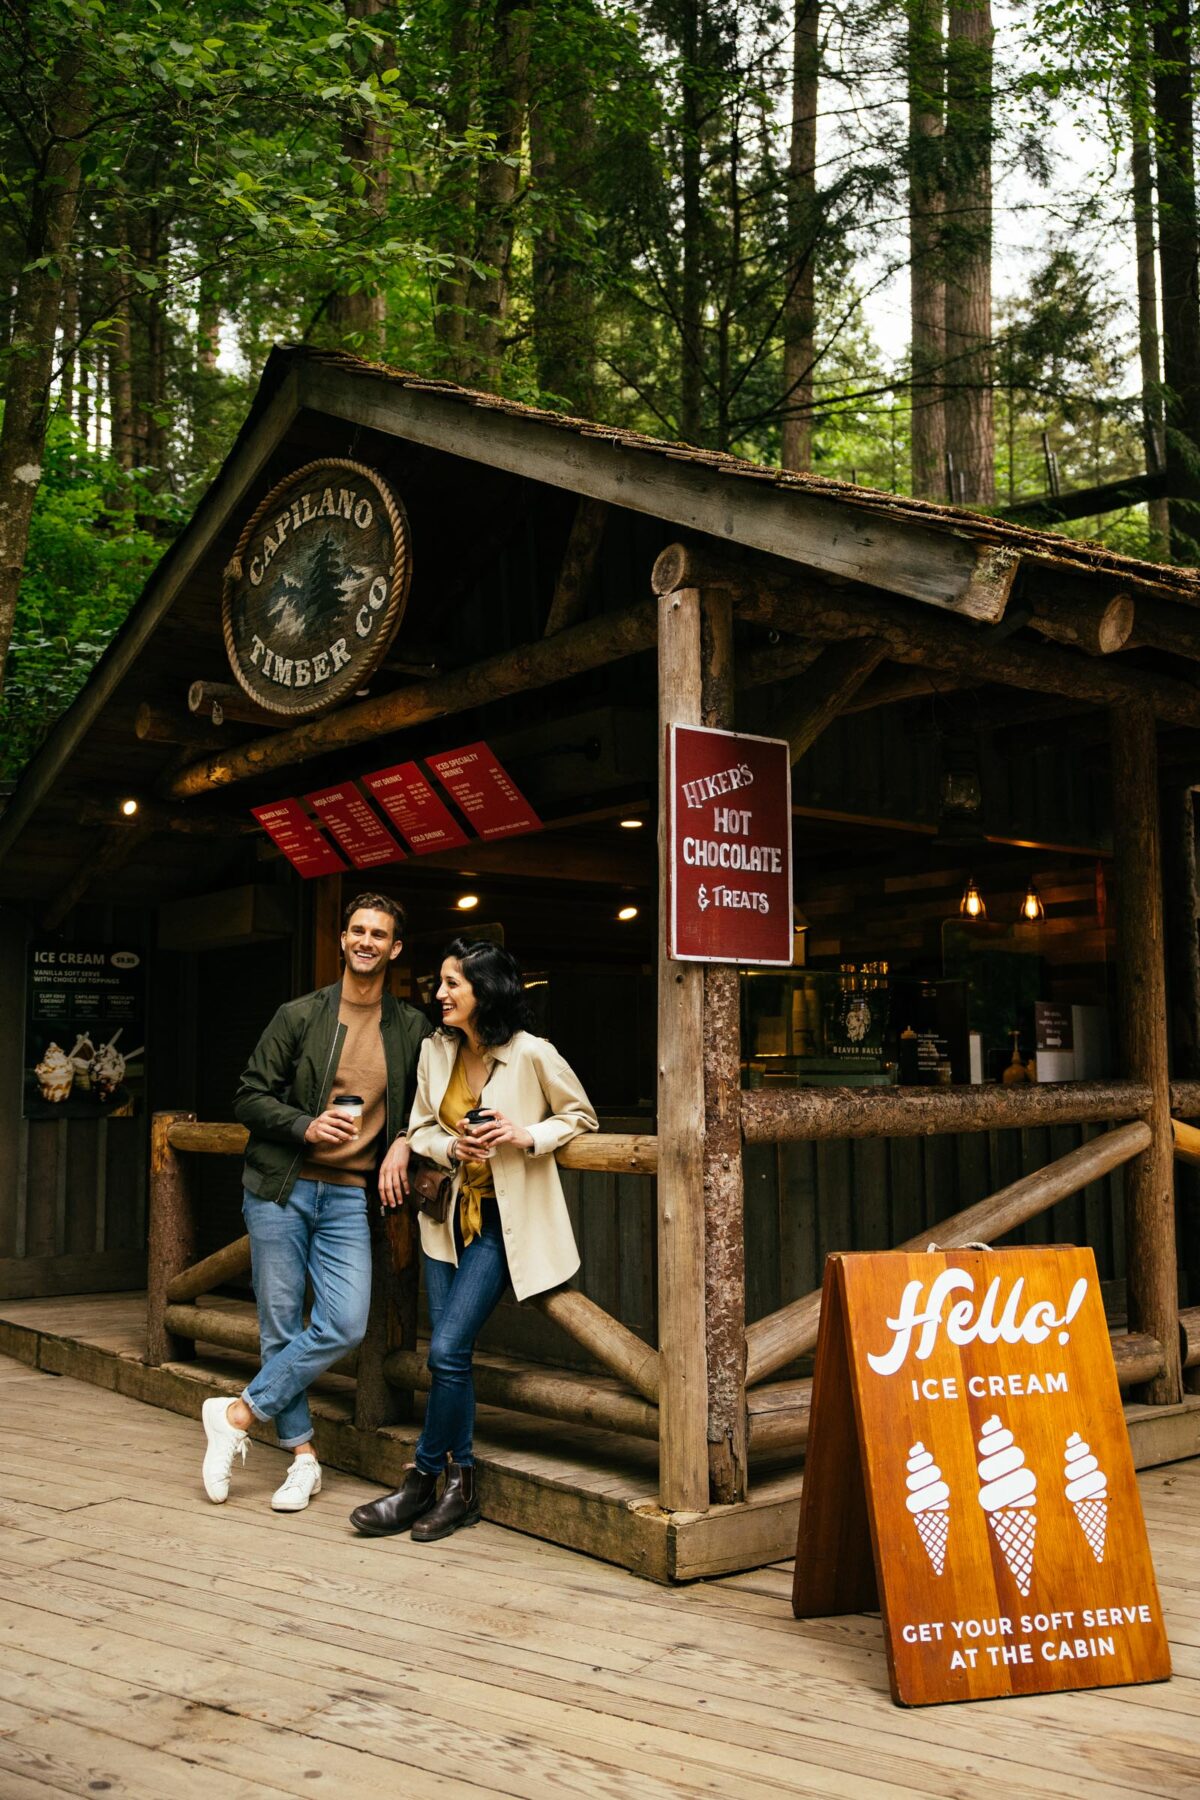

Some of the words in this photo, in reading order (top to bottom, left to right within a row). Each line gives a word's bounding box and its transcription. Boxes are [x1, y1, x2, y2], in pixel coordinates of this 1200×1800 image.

[250, 488, 373, 586] CAPILANO
[250, 634, 351, 688] TIMBER
[449, 753, 479, 766] SPECIALTY
[681, 763, 754, 809] HIKER'S
[713, 807, 752, 836] HOT
[683, 837, 782, 873] CHOCOLATE
[698, 884, 711, 911] &
[712, 885, 769, 914] TREATS
[34, 951, 56, 963] ICE
[59, 952, 105, 965] CREAM
[867, 1268, 1088, 1376] Hello!
[912, 1378, 959, 1401] ICE
[969, 1373, 1069, 1397] CREAM
[902, 1621, 944, 1644] GET
[951, 1617, 1013, 1640] YOUR
[1020, 1612, 1075, 1633] SOFT
[1083, 1605, 1152, 1628] SERVE
[950, 1650, 978, 1670] AT
[986, 1644, 1034, 1666] THE
[1042, 1637, 1115, 1660] CABIN
